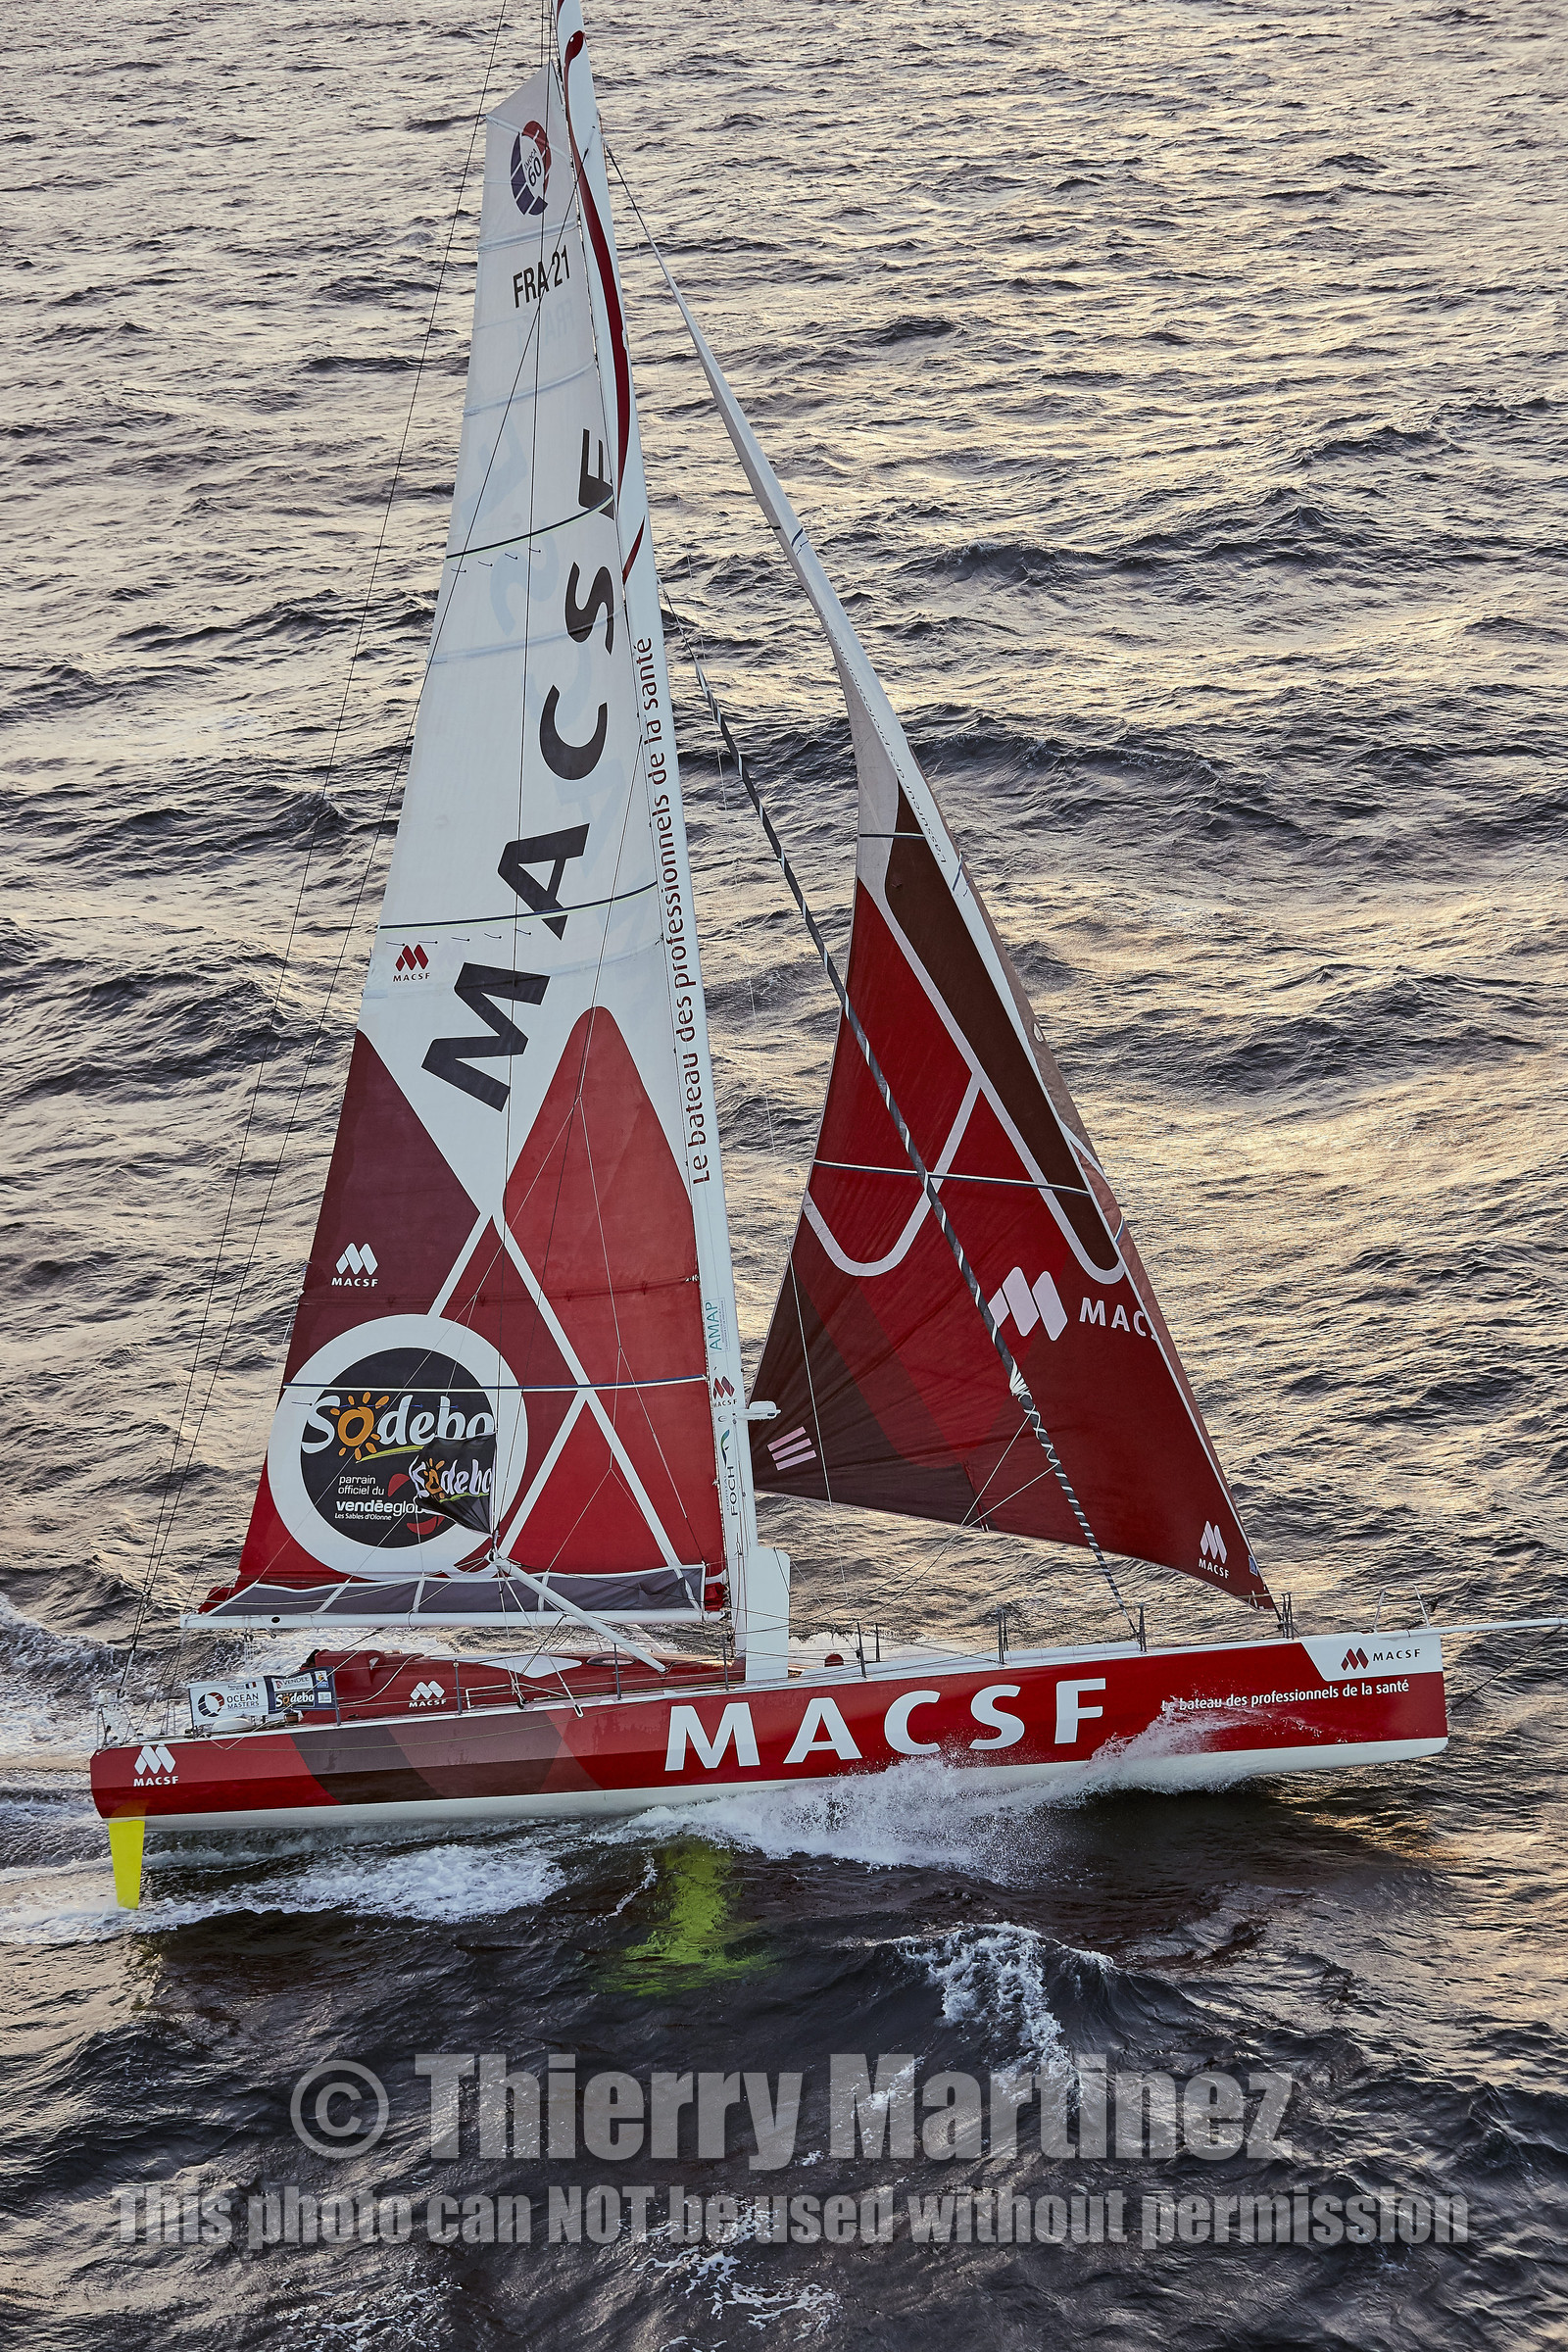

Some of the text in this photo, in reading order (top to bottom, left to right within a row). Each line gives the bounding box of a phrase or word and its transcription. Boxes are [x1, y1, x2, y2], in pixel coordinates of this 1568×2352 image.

[527, 157, 542, 187] 60
[513, 245, 570, 309] FRA 21
[421, 428, 615, 1113] MACSF
[633, 638, 710, 1185] Le bateau des professionnels de la santé
[393, 972, 430, 982] MACSF
[331, 1277, 379, 1288] MACSF
[706, 1301, 722, 1350] AMAP
[1079, 1297, 1156, 1342] MAC
[301, 1394, 496, 1454] Sodebo
[338, 1485, 385, 1495] officiel du
[339, 1475, 376, 1486] parrain
[727, 1466, 738, 1516] FOCH
[1199, 1558, 1230, 1579] MACSF
[1373, 1648, 1421, 1662] MACSF
[226, 1692, 259, 1703] OCEAN
[227, 1700, 260, 1709] MASTERS
[275, 1691, 315, 1707] Sodebo
[409, 1698, 447, 1708] MACSF
[1179, 1697, 1223, 1711] bateau
[1227, 1694, 1248, 1707] des
[1250, 1685, 1340, 1708] professionnels
[1343, 1684, 1358, 1697] de
[1361, 1683, 1373, 1695] la
[1376, 1679, 1410, 1694] santé
[664, 1677, 1106, 1772] MACSF
[133, 1775, 179, 1787] MACSF
